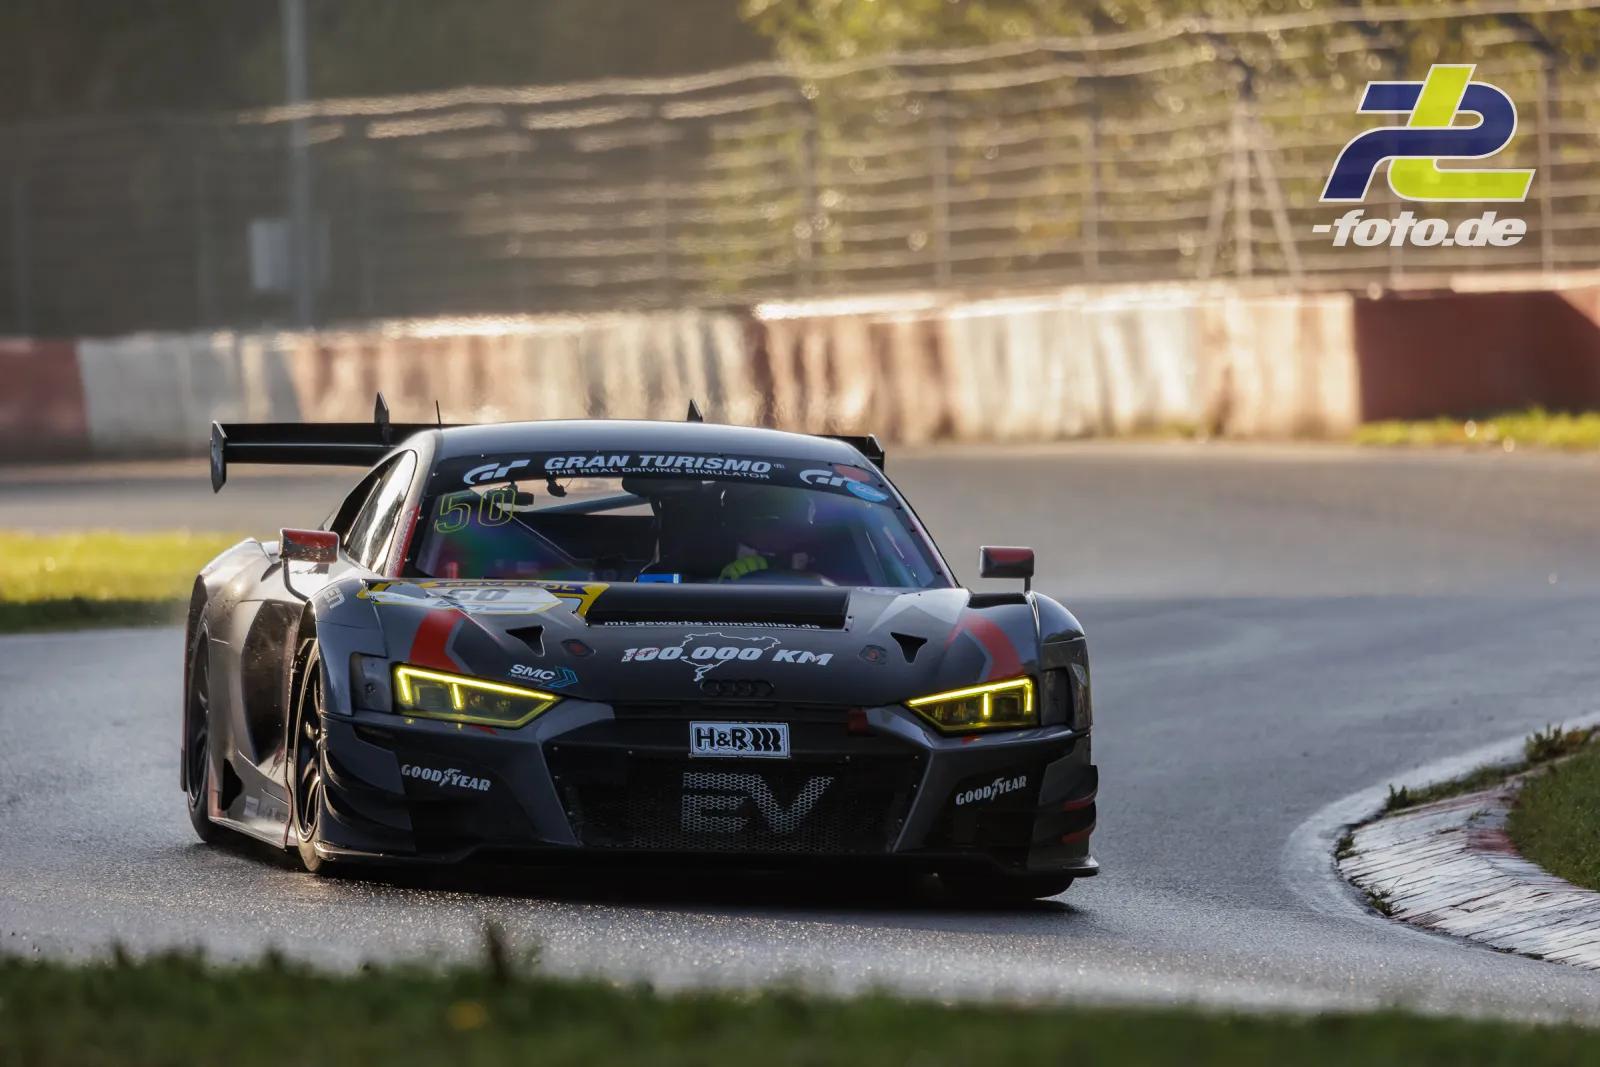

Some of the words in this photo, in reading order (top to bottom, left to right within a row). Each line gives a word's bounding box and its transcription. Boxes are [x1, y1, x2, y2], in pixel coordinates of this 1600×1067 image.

[544, 455, 630, 471] GRAN
[685, 468, 770, 479] SIMULATOR
[434, 487, 516, 533] 50
[621, 646, 763, 662] 100.000
[772, 649, 834, 666] KM
[510, 664, 556, 680] SMC
[695, 727, 754, 751] H&R
[401, 764, 492, 791] GOODYEAR
[681, 772, 835, 833] EV
[956, 776, 1027, 805] GOODYEAR
